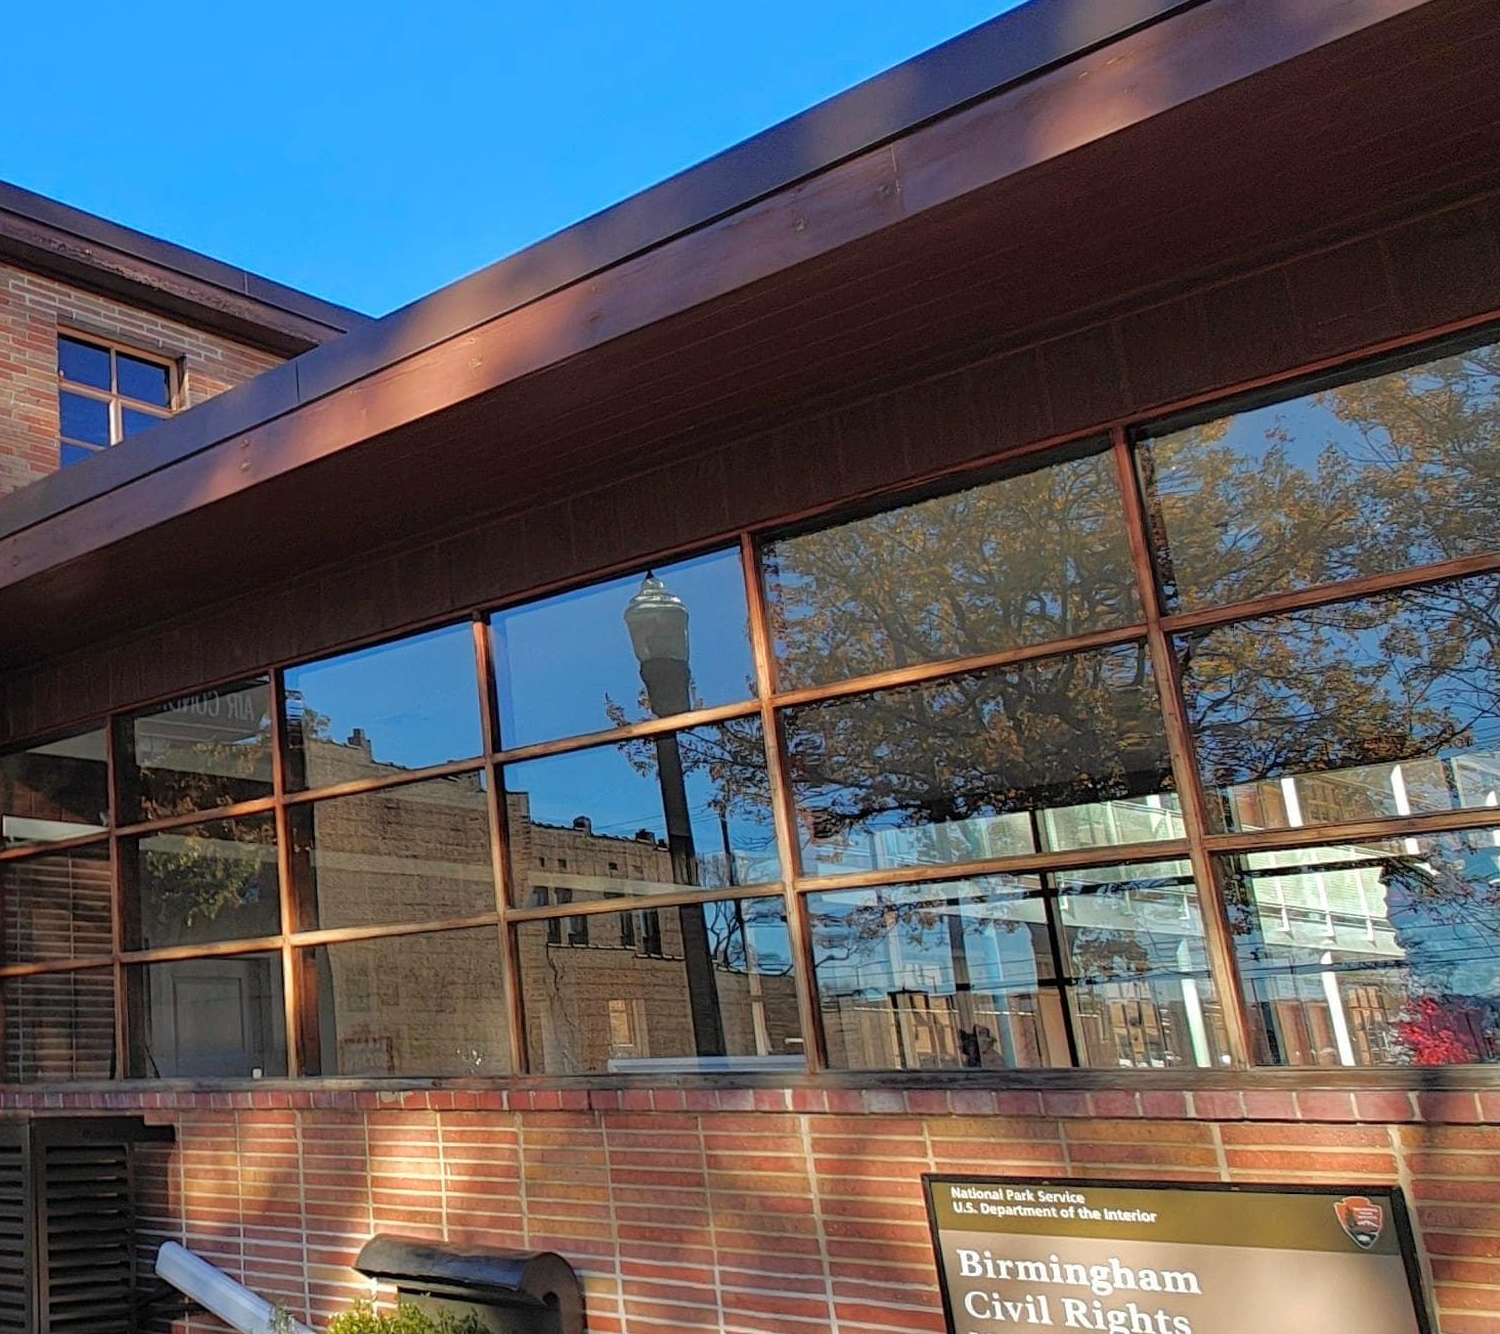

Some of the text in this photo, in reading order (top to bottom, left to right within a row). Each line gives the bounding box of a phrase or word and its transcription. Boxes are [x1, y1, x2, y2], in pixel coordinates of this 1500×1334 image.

[950, 1186, 1085, 1204] National Park Service
[953, 1201, 1157, 1223] U.S. Department of the Interior
[956, 1248, 1203, 1297] Birmingham
[963, 1290, 1053, 1326] Civil
